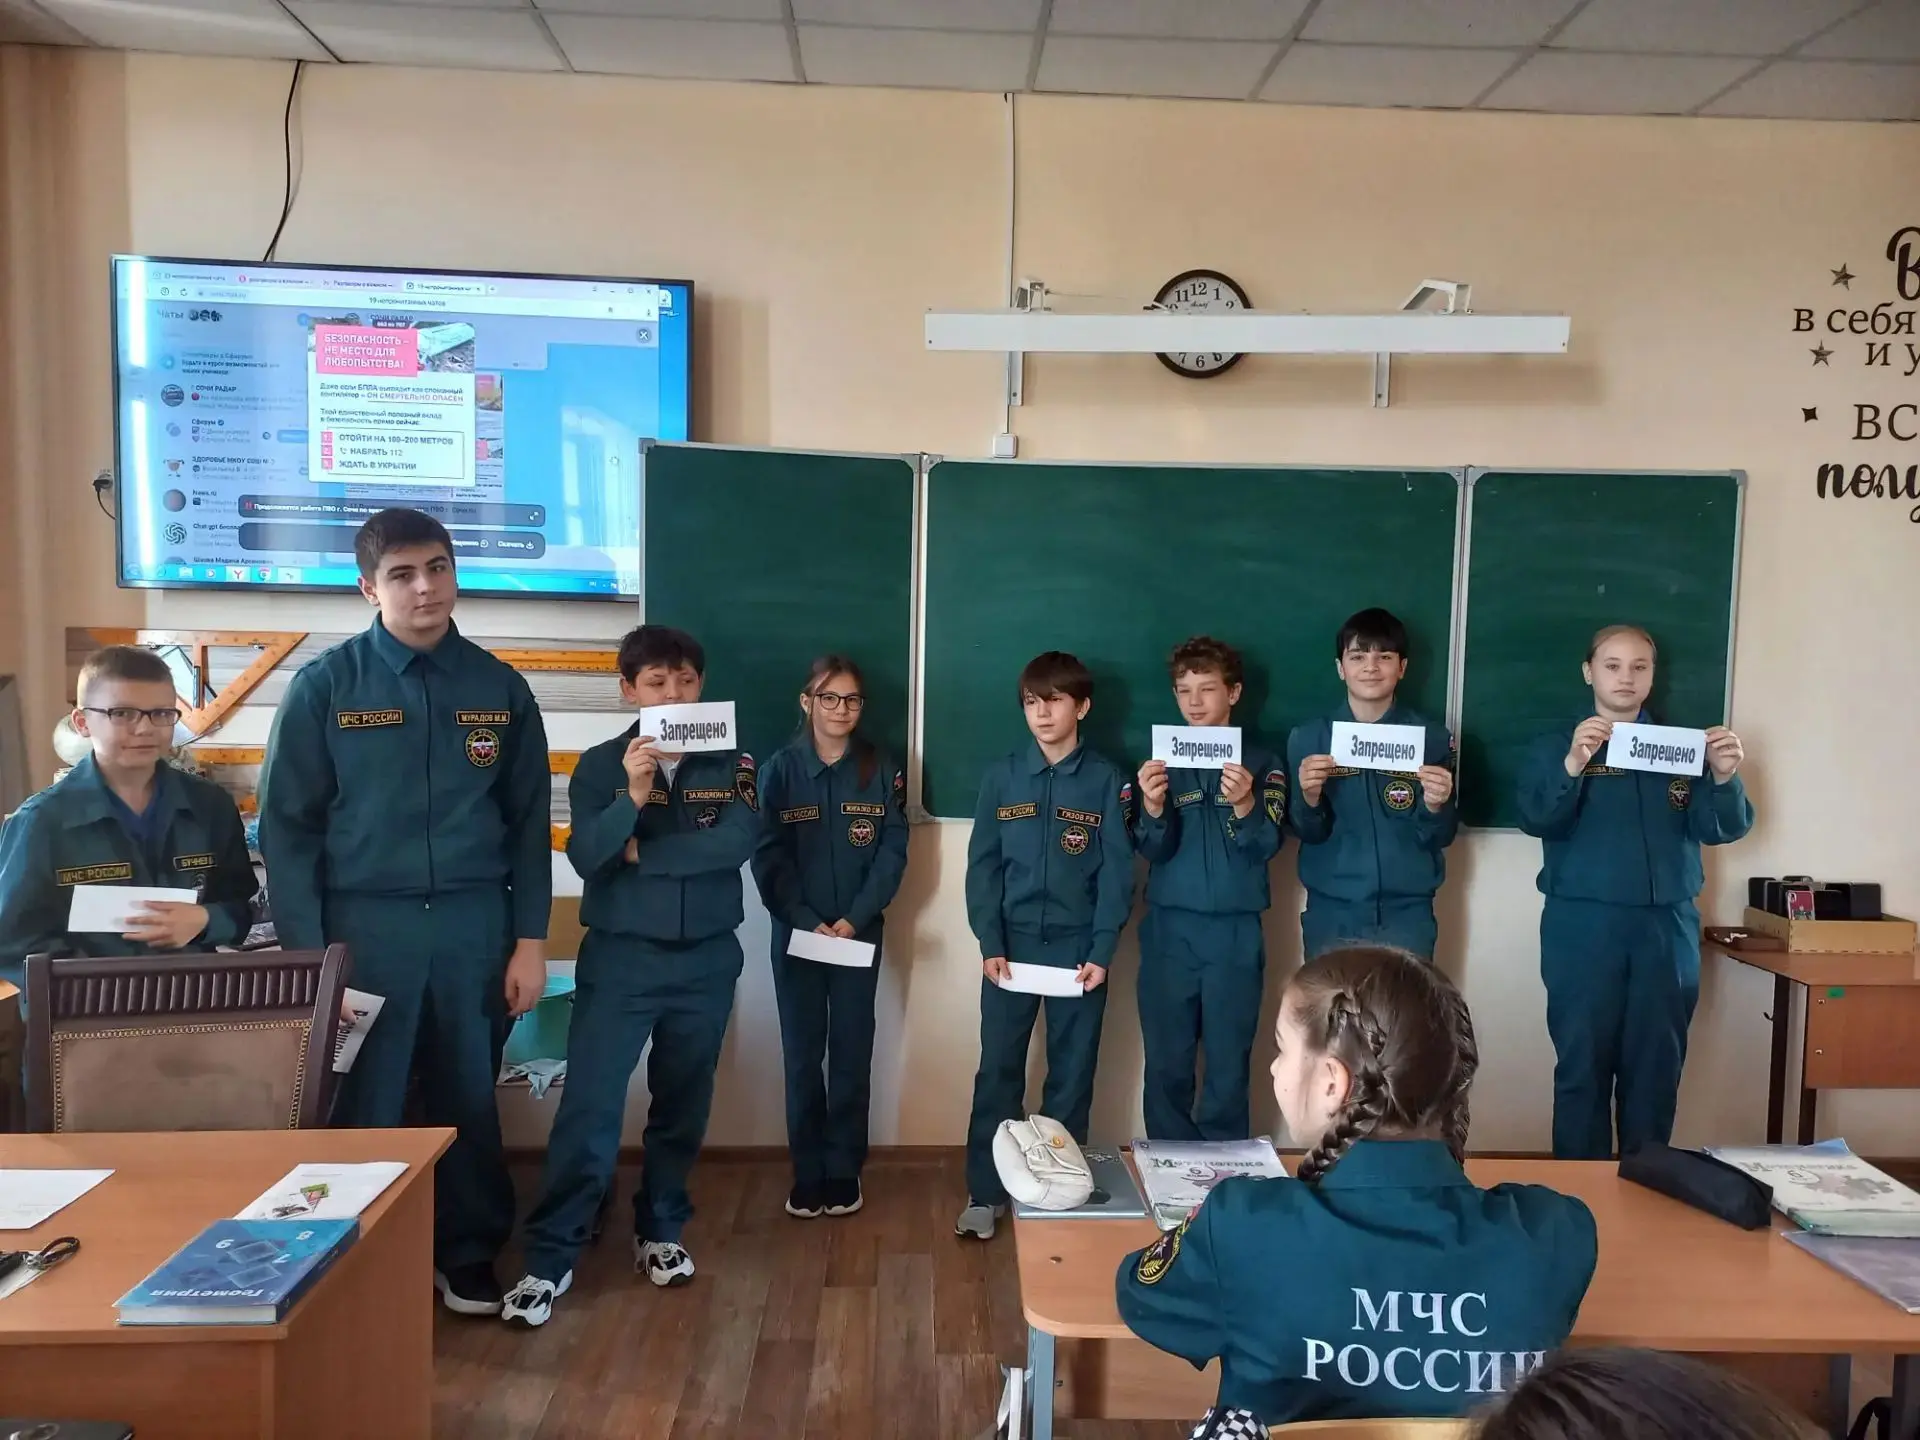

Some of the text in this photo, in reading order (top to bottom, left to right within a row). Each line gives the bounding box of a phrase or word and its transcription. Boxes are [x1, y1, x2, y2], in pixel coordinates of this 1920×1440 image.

[1190, 282, 1208, 296] 12
[1213, 287, 1222, 301] 1
[1175, 289, 1190, 303] 11
[1792, 302, 1917, 335] в себя
[324, 334, 402, 345] БЕЗОПАСНОСТЬ
[324, 346, 396, 357] НЕ МЕСТО ДЛЯ
[1864, 342, 1892, 367] и
[324, 358, 405, 369] ЛЮБОПЫТСТВА!
[1196, 355, 1205, 368] 6
[380, 392, 431, 401] СМЕРТЕЛЬНО
[432, 394, 464, 402] ОПАСЕН
[339, 433, 372, 442] ОТОЙТИ
[420, 437, 454, 446] МЕТРОВ
[350, 448, 388, 456] НАБРАТЬ
[339, 461, 368, 469] ЖДАТЬ
[377, 462, 417, 470] УКРЫТИИ
[341, 712, 399, 726] МЧС РОССИИ
[461, 713, 493, 723] МУРАДОВ
[660, 718, 727, 746] Запрещено
[1172, 736, 1233, 762] Запрещено
[1351, 734, 1415, 762] Запрещено
[1629, 736, 1696, 765] Запрещено
[1179, 791, 1202, 803] РОССИИ
[1000, 806, 1034, 818] МЧС РОССИИ
[1061, 810, 1084, 821] ГЯЗОВ
[62, 866, 128, 883] МЧС РОССИИ
[271, 1254, 291, 1264] 7
[150, 1288, 264, 1297] Геометрия
[1350, 1287, 1488, 1337] МЧС
[1301, 1336, 1547, 1393] РОССИИ
